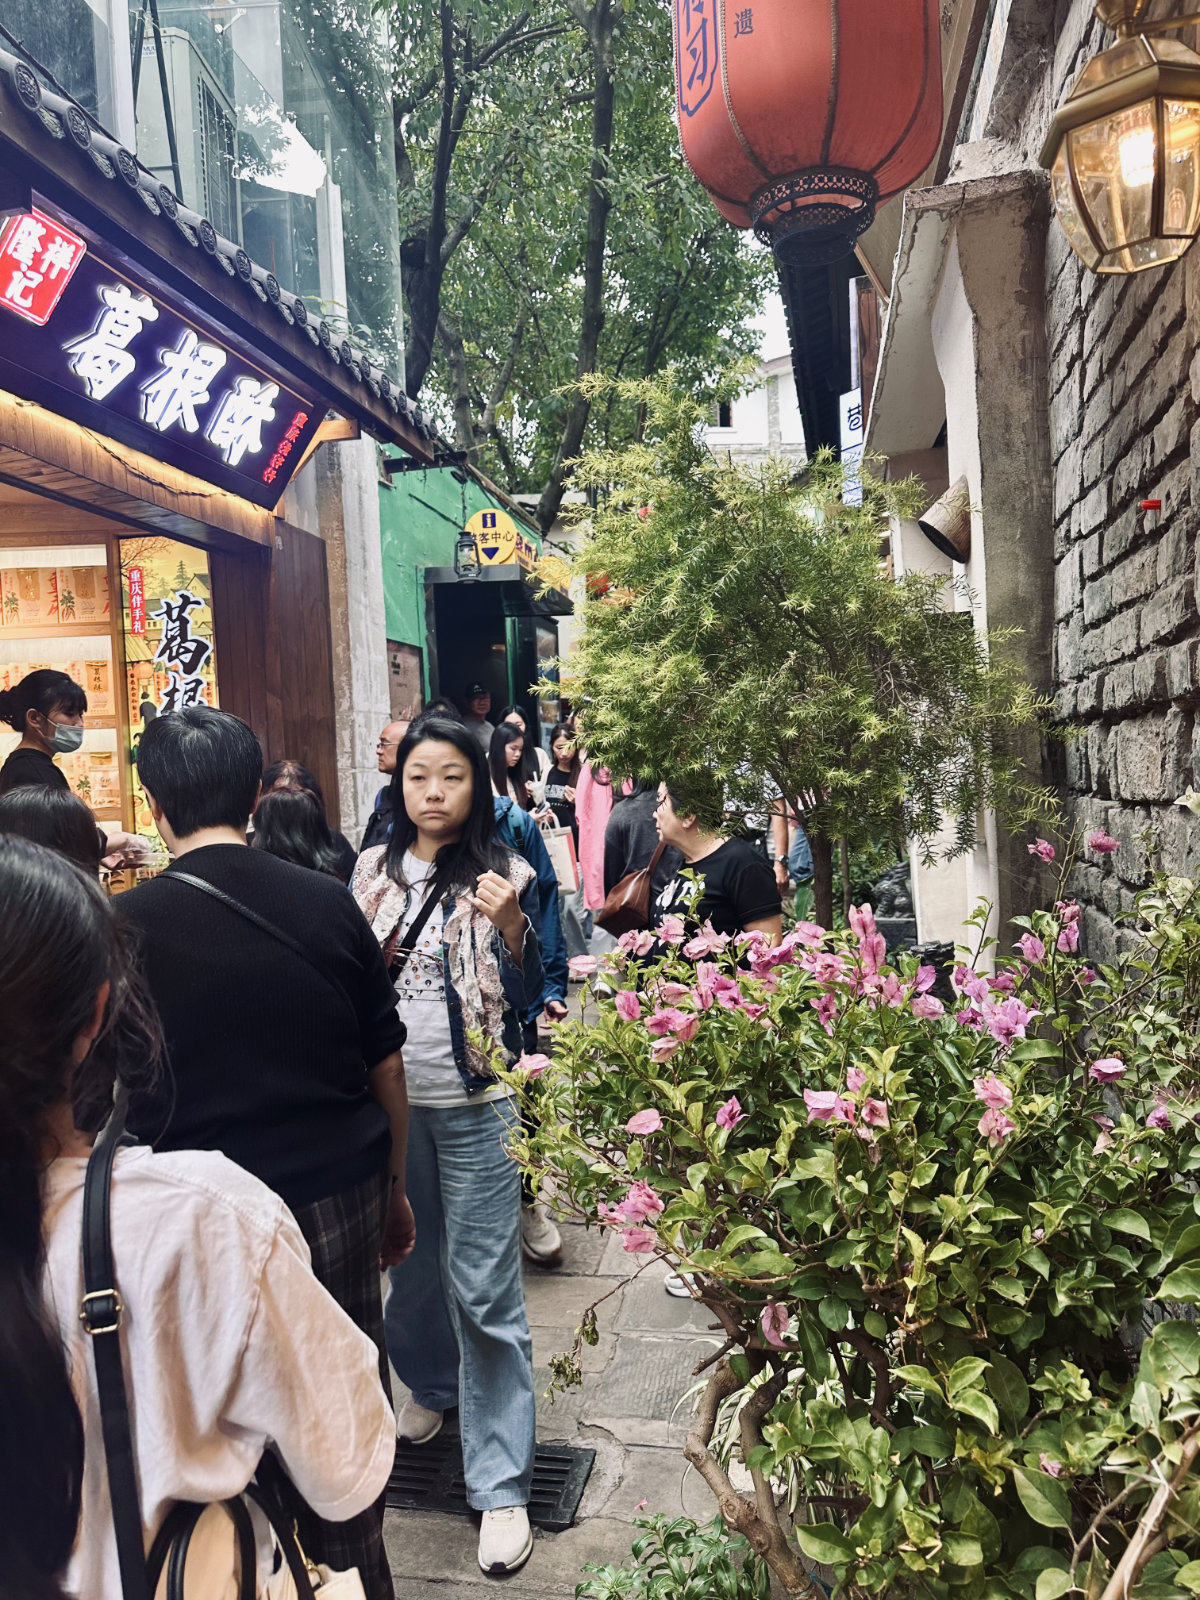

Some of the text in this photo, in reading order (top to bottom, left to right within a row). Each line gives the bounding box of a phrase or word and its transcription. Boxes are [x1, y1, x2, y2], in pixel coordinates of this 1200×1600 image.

[733, 8, 754, 38] 遗
[62, 283, 280, 466] 葛根酥
[130, 570, 145, 633] 重庆伴手礼
